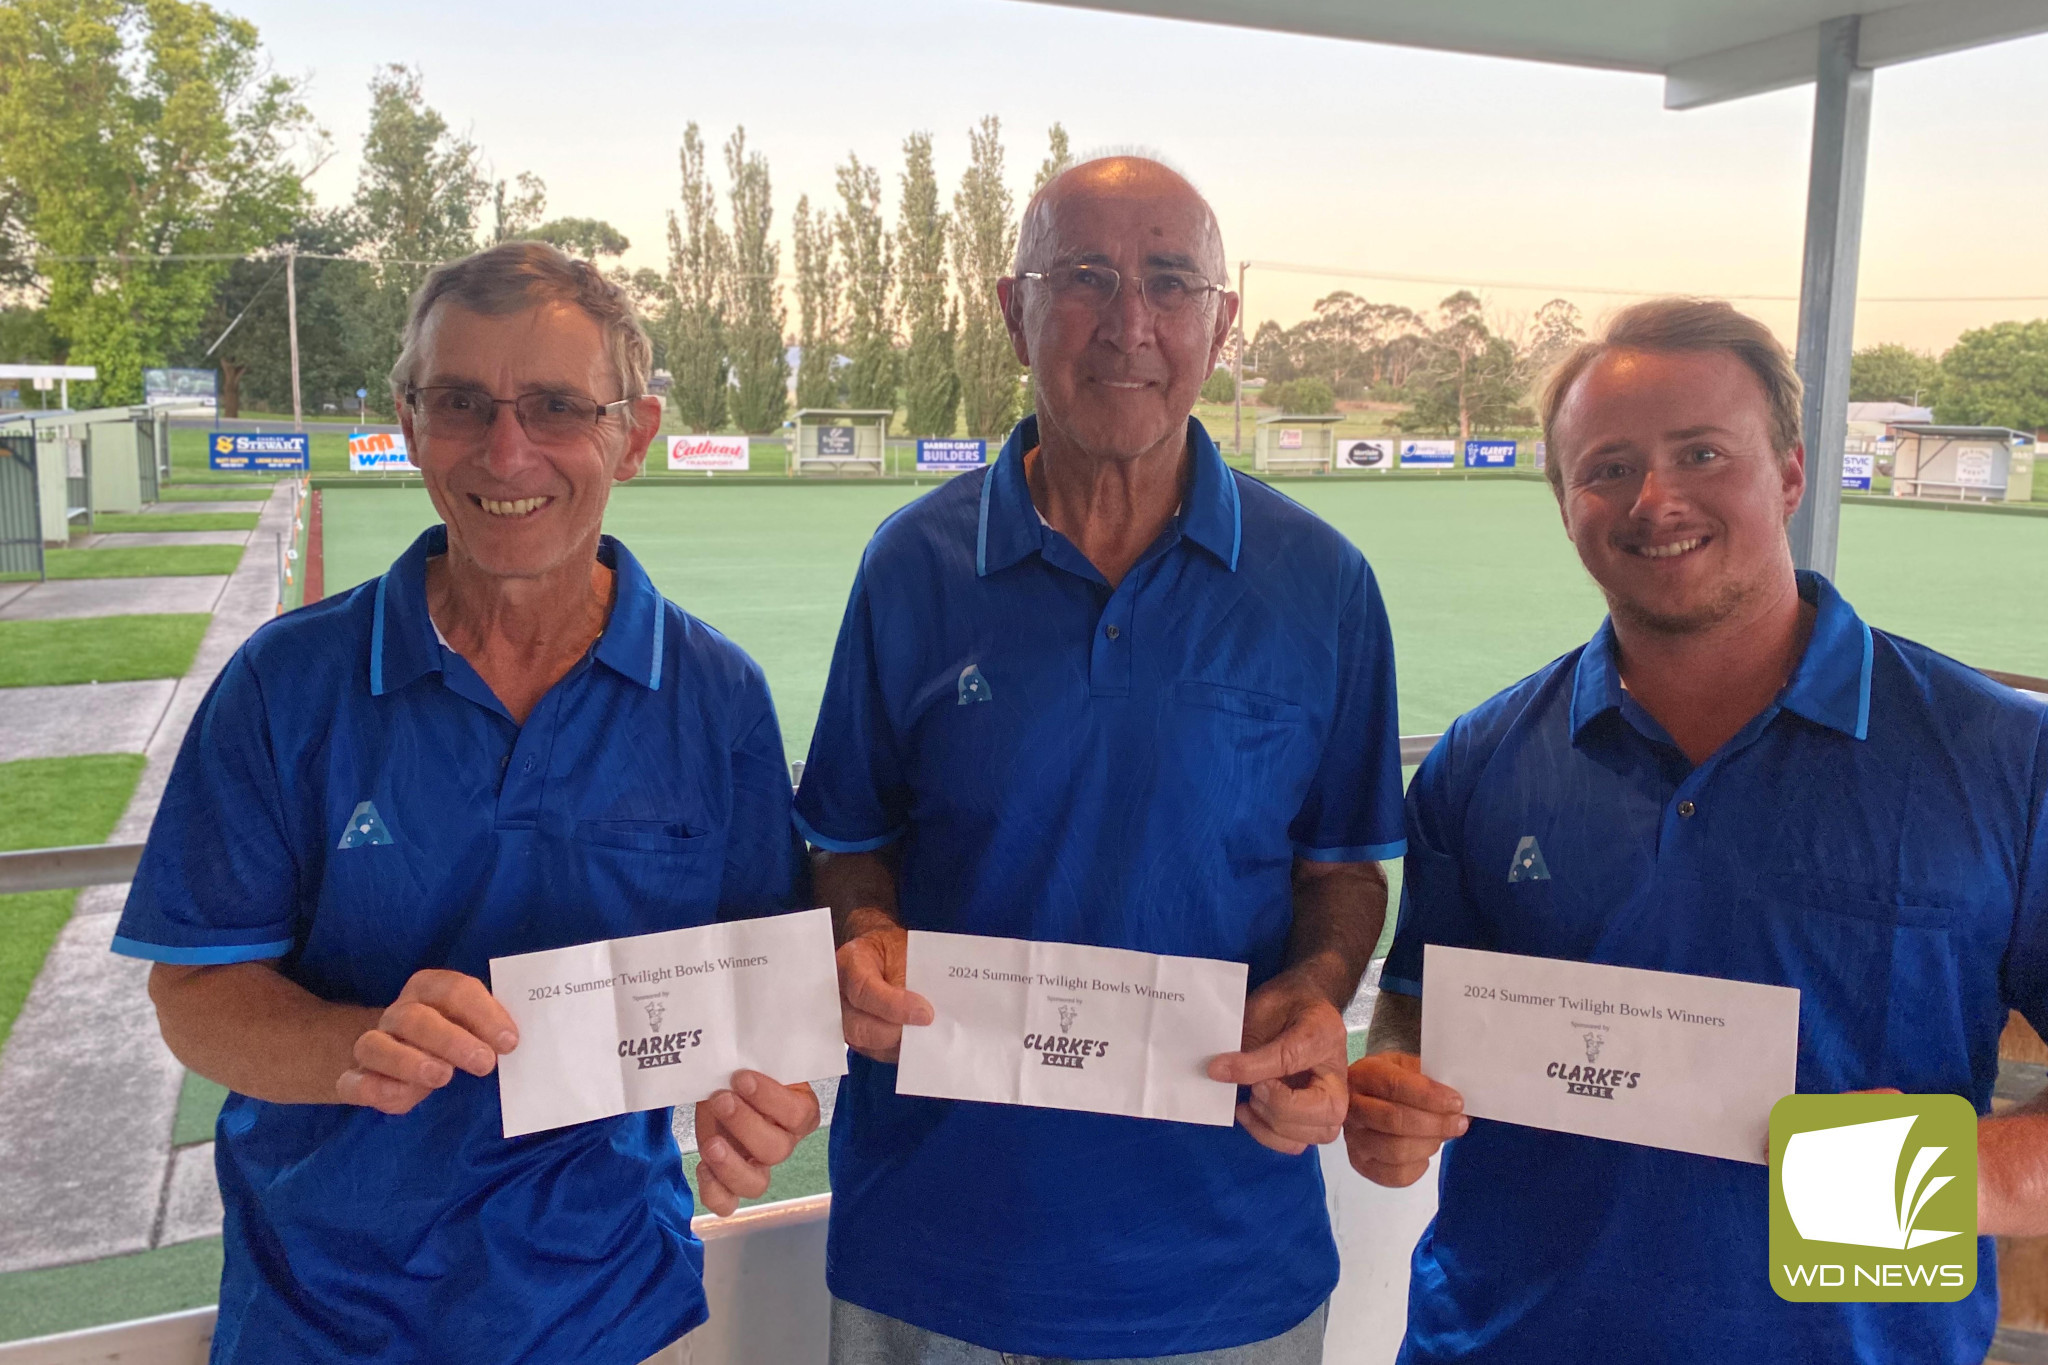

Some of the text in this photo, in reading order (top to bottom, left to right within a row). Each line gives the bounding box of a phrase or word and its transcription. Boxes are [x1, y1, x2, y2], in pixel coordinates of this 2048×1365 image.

[237, 437, 304, 450] STEWART
[923, 442, 980, 450] DARREN GRANT
[923, 450, 980, 461] BUILDERS
[1479, 446, 1514, 456] CLARKE'S
[1844, 456, 1869, 465] STVIC
[528, 954, 768, 1001] 2024 Summer Twilight Bowls Winners
[948, 966, 1185, 1002] 2024 Summer Twilight Bowls Winners
[1463, 984, 1726, 1027] 2024 Summer Twilight Bowls Winners
[617, 1029, 703, 1058] CLARKE'S
[1023, 1033, 1109, 1058] CLARKE'S
[642, 1055, 675, 1067] CAFE
[1047, 1055, 1077, 1067] CAFE
[1546, 1061, 1641, 1089] CLARKE'S
[1573, 1084, 1606, 1097] CAFE
